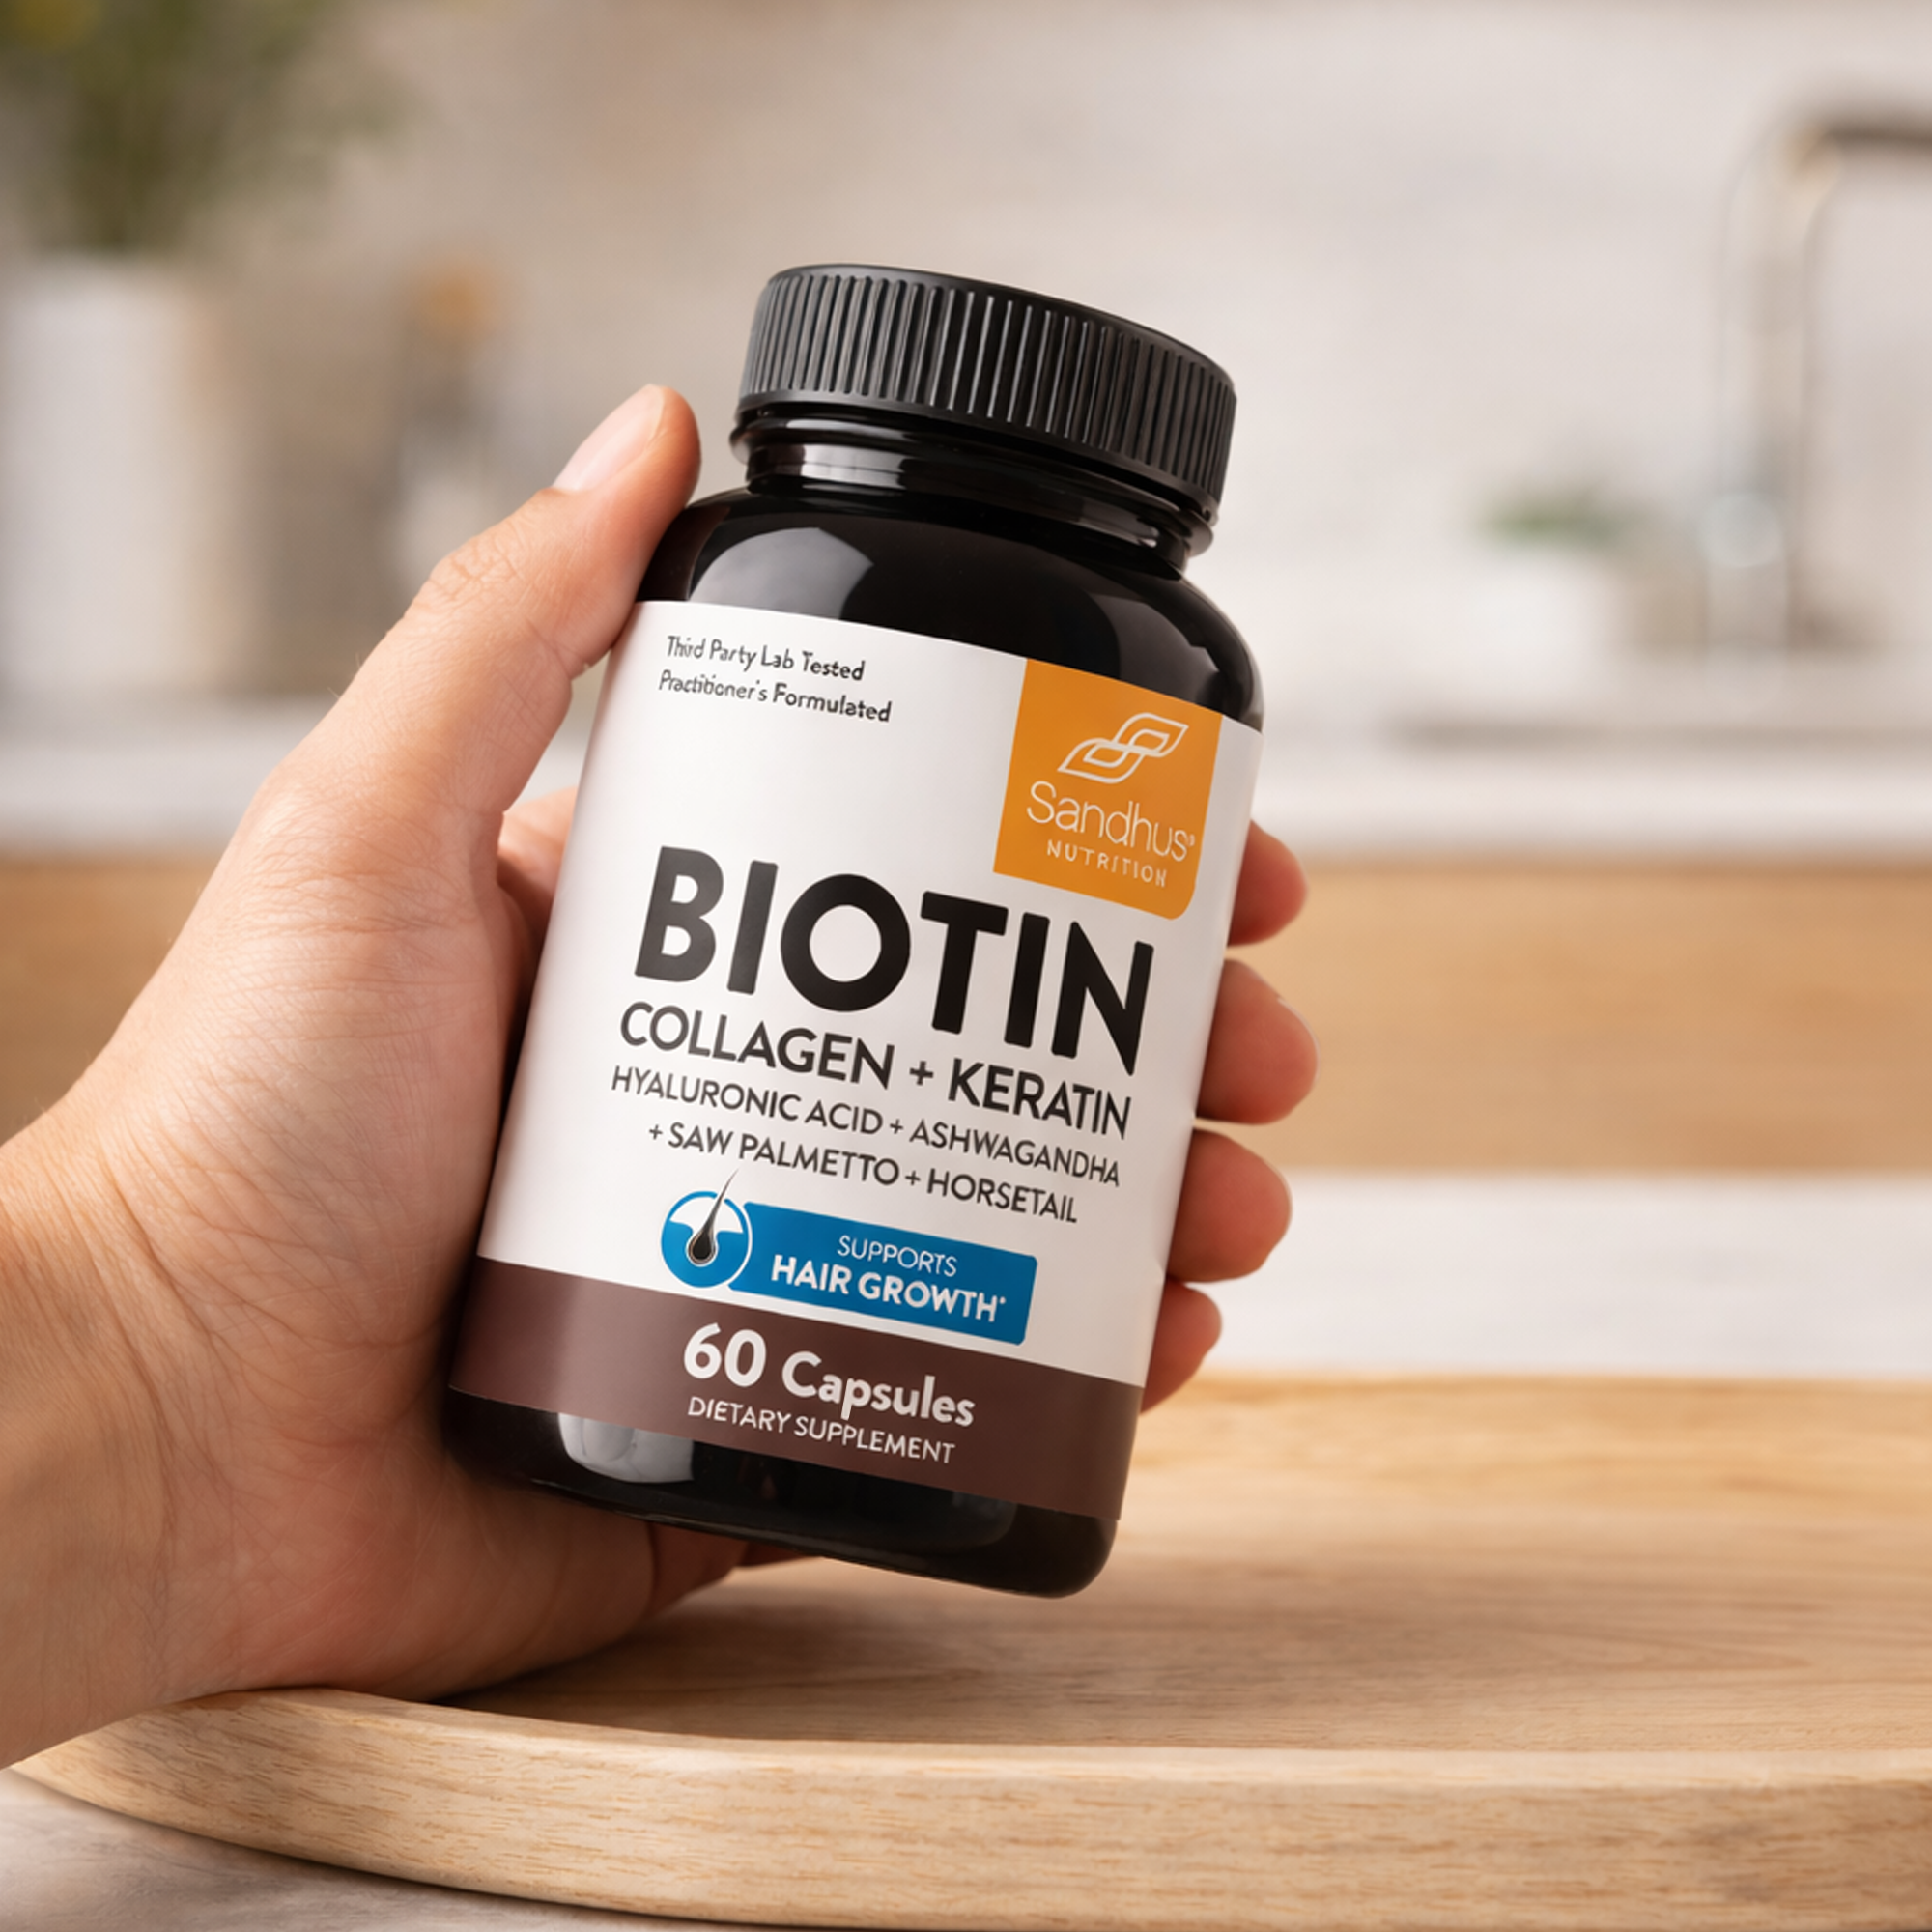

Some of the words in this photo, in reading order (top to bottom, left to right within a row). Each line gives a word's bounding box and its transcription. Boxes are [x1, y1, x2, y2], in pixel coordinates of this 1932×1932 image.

[667, 636, 706, 659] Third
[709, 639, 756, 671] Party
[761, 645, 794, 669] Lab
[802, 651, 866, 681] Tested
[773, 683, 892, 722] Formulated
[1047, 839, 1167, 887] NUTRITION
[634, 846, 1154, 1076] BIOTIN
[620, 1002, 895, 1090] COLLAGEN
[909, 1061, 934, 1086] +
[948, 1058, 1131, 1140] KERATIN
[611, 1065, 801, 1122] HYALURONIC
[805, 1100, 883, 1135] ACID
[889, 1119, 904, 1135] +
[909, 1119, 1120, 1187] ASHWAGANDHA
[648, 1123, 664, 1141] +
[668, 1122, 734, 1155] SAW
[739, 1133, 899, 1186] PALMETTO
[905, 1170, 921, 1186] +
[927, 1168, 1077, 1223] HORSETAIL
[771, 1255, 852, 1294] HAIR
[838, 1235, 957, 1277] SUPPORTS
[683, 1322, 766, 1387] 60
[781, 1350, 975, 1427] Capsules
[688, 1397, 790, 1434] DIETARY
[794, 1416, 954, 1463] SUPPLEMENT
